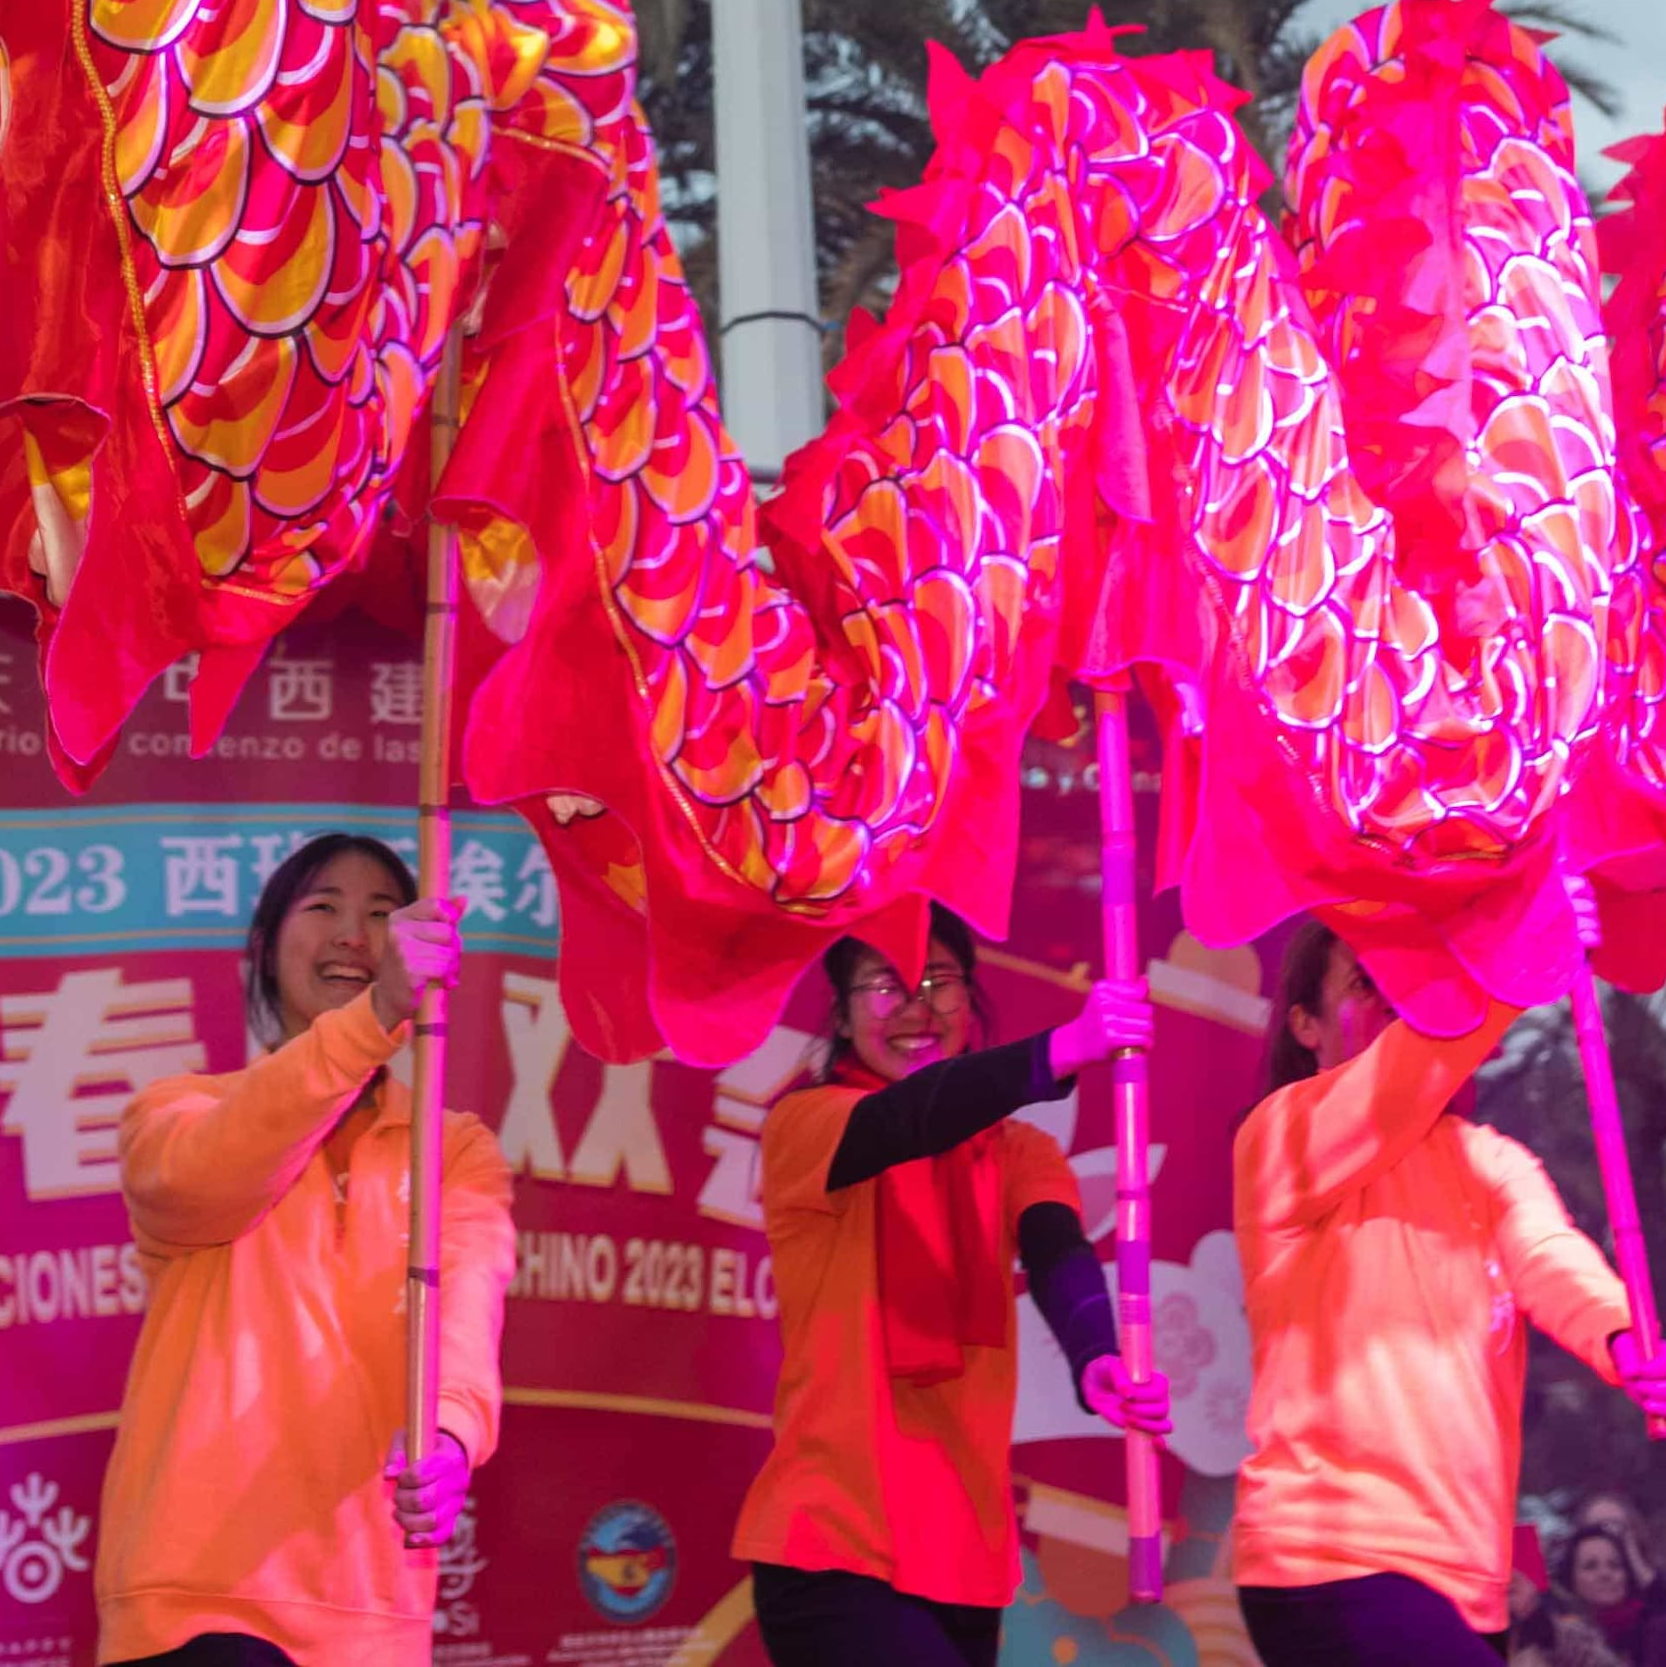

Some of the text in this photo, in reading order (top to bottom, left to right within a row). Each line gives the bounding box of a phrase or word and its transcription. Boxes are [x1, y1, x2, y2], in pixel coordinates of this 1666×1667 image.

[128, 730, 304, 763] comenzo
[319, 733, 362, 760] de
[622, 1236, 705, 1313] 2023
